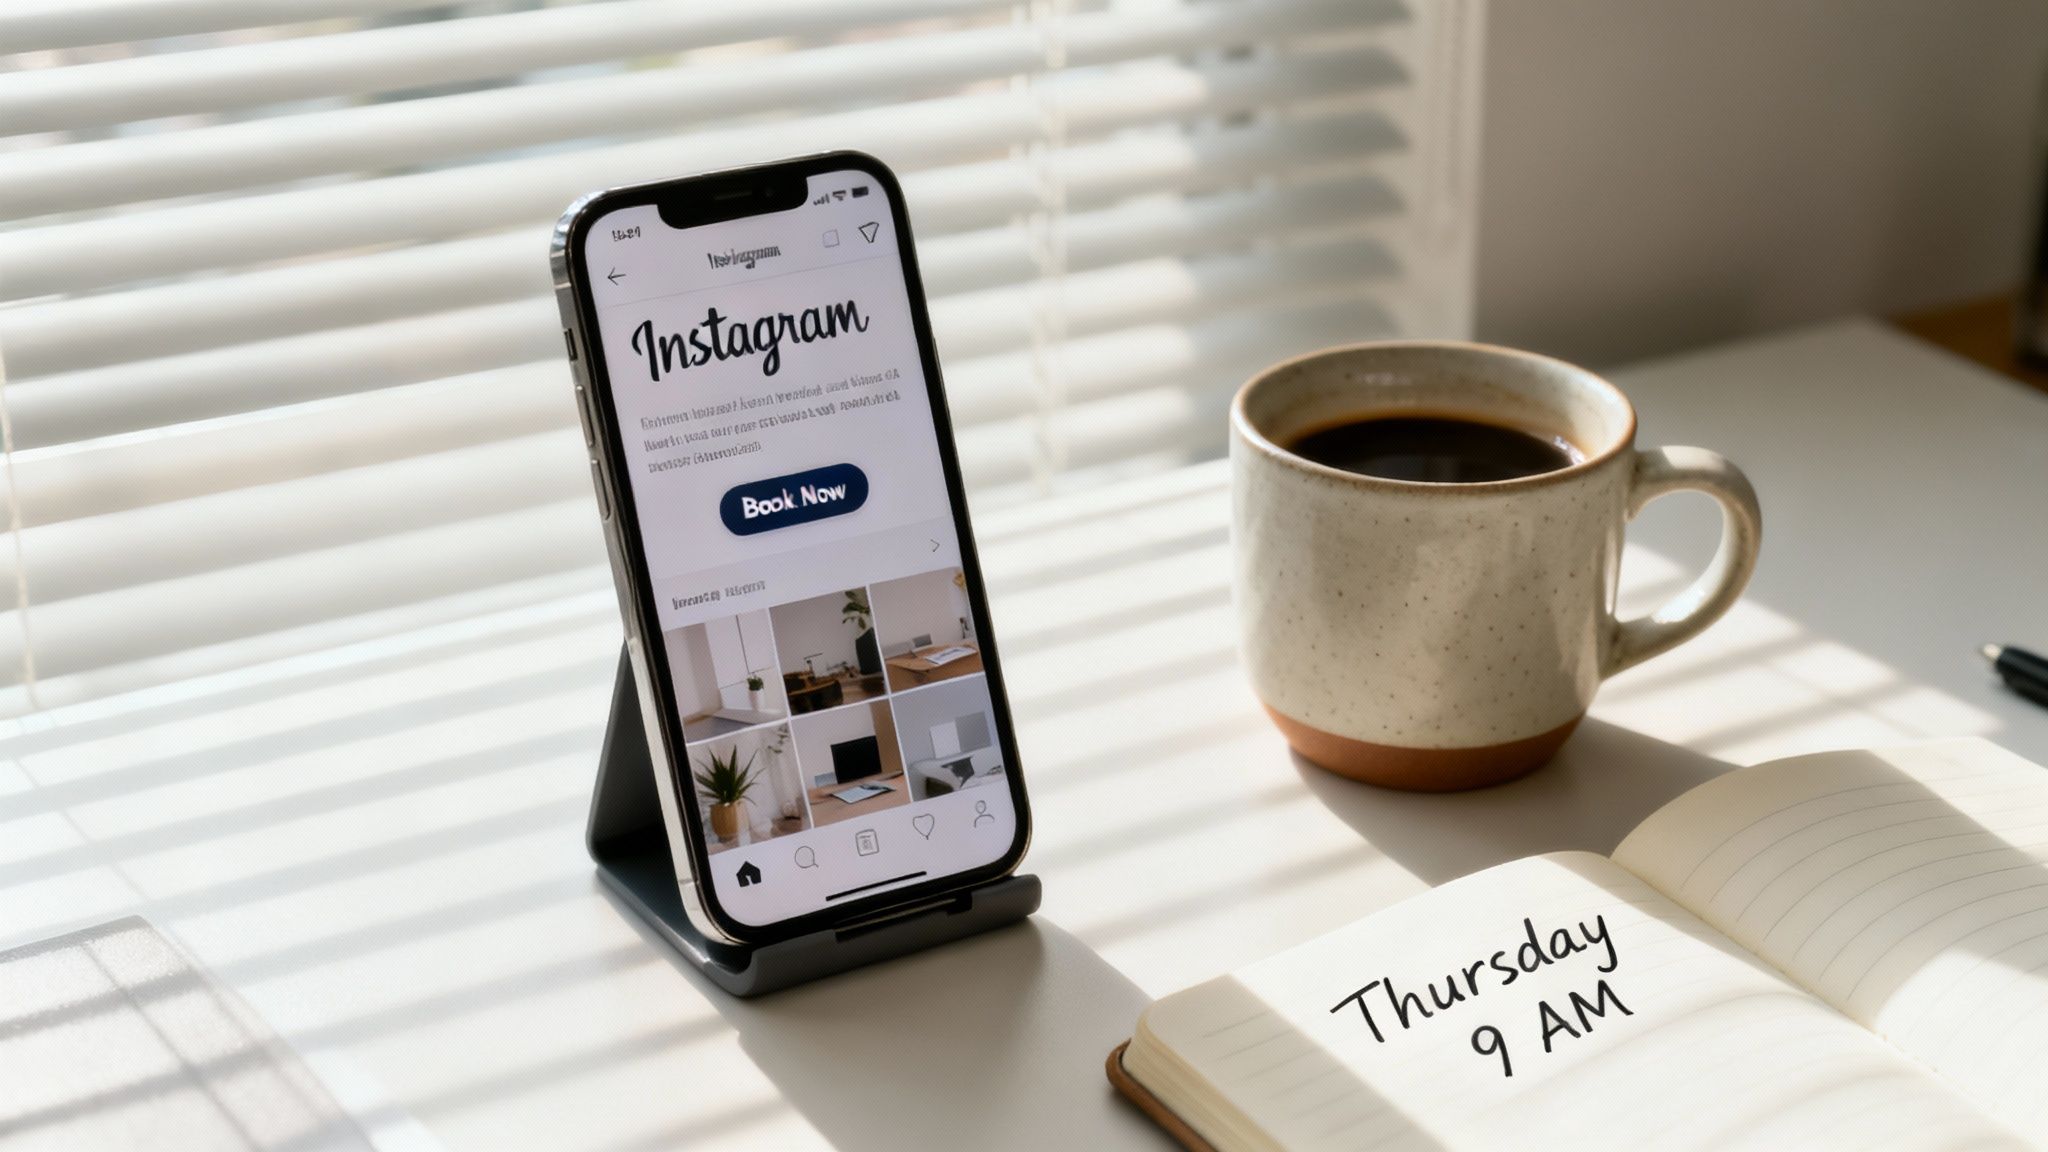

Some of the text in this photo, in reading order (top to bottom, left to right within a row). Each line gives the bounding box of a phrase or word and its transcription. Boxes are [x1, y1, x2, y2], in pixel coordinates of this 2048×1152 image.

[631, 299, 870, 382] Instagram
[741, 483, 846, 519] Book Now
[1330, 914, 1618, 1043] Thursday
[1471, 979, 1634, 1078] 9 AM
